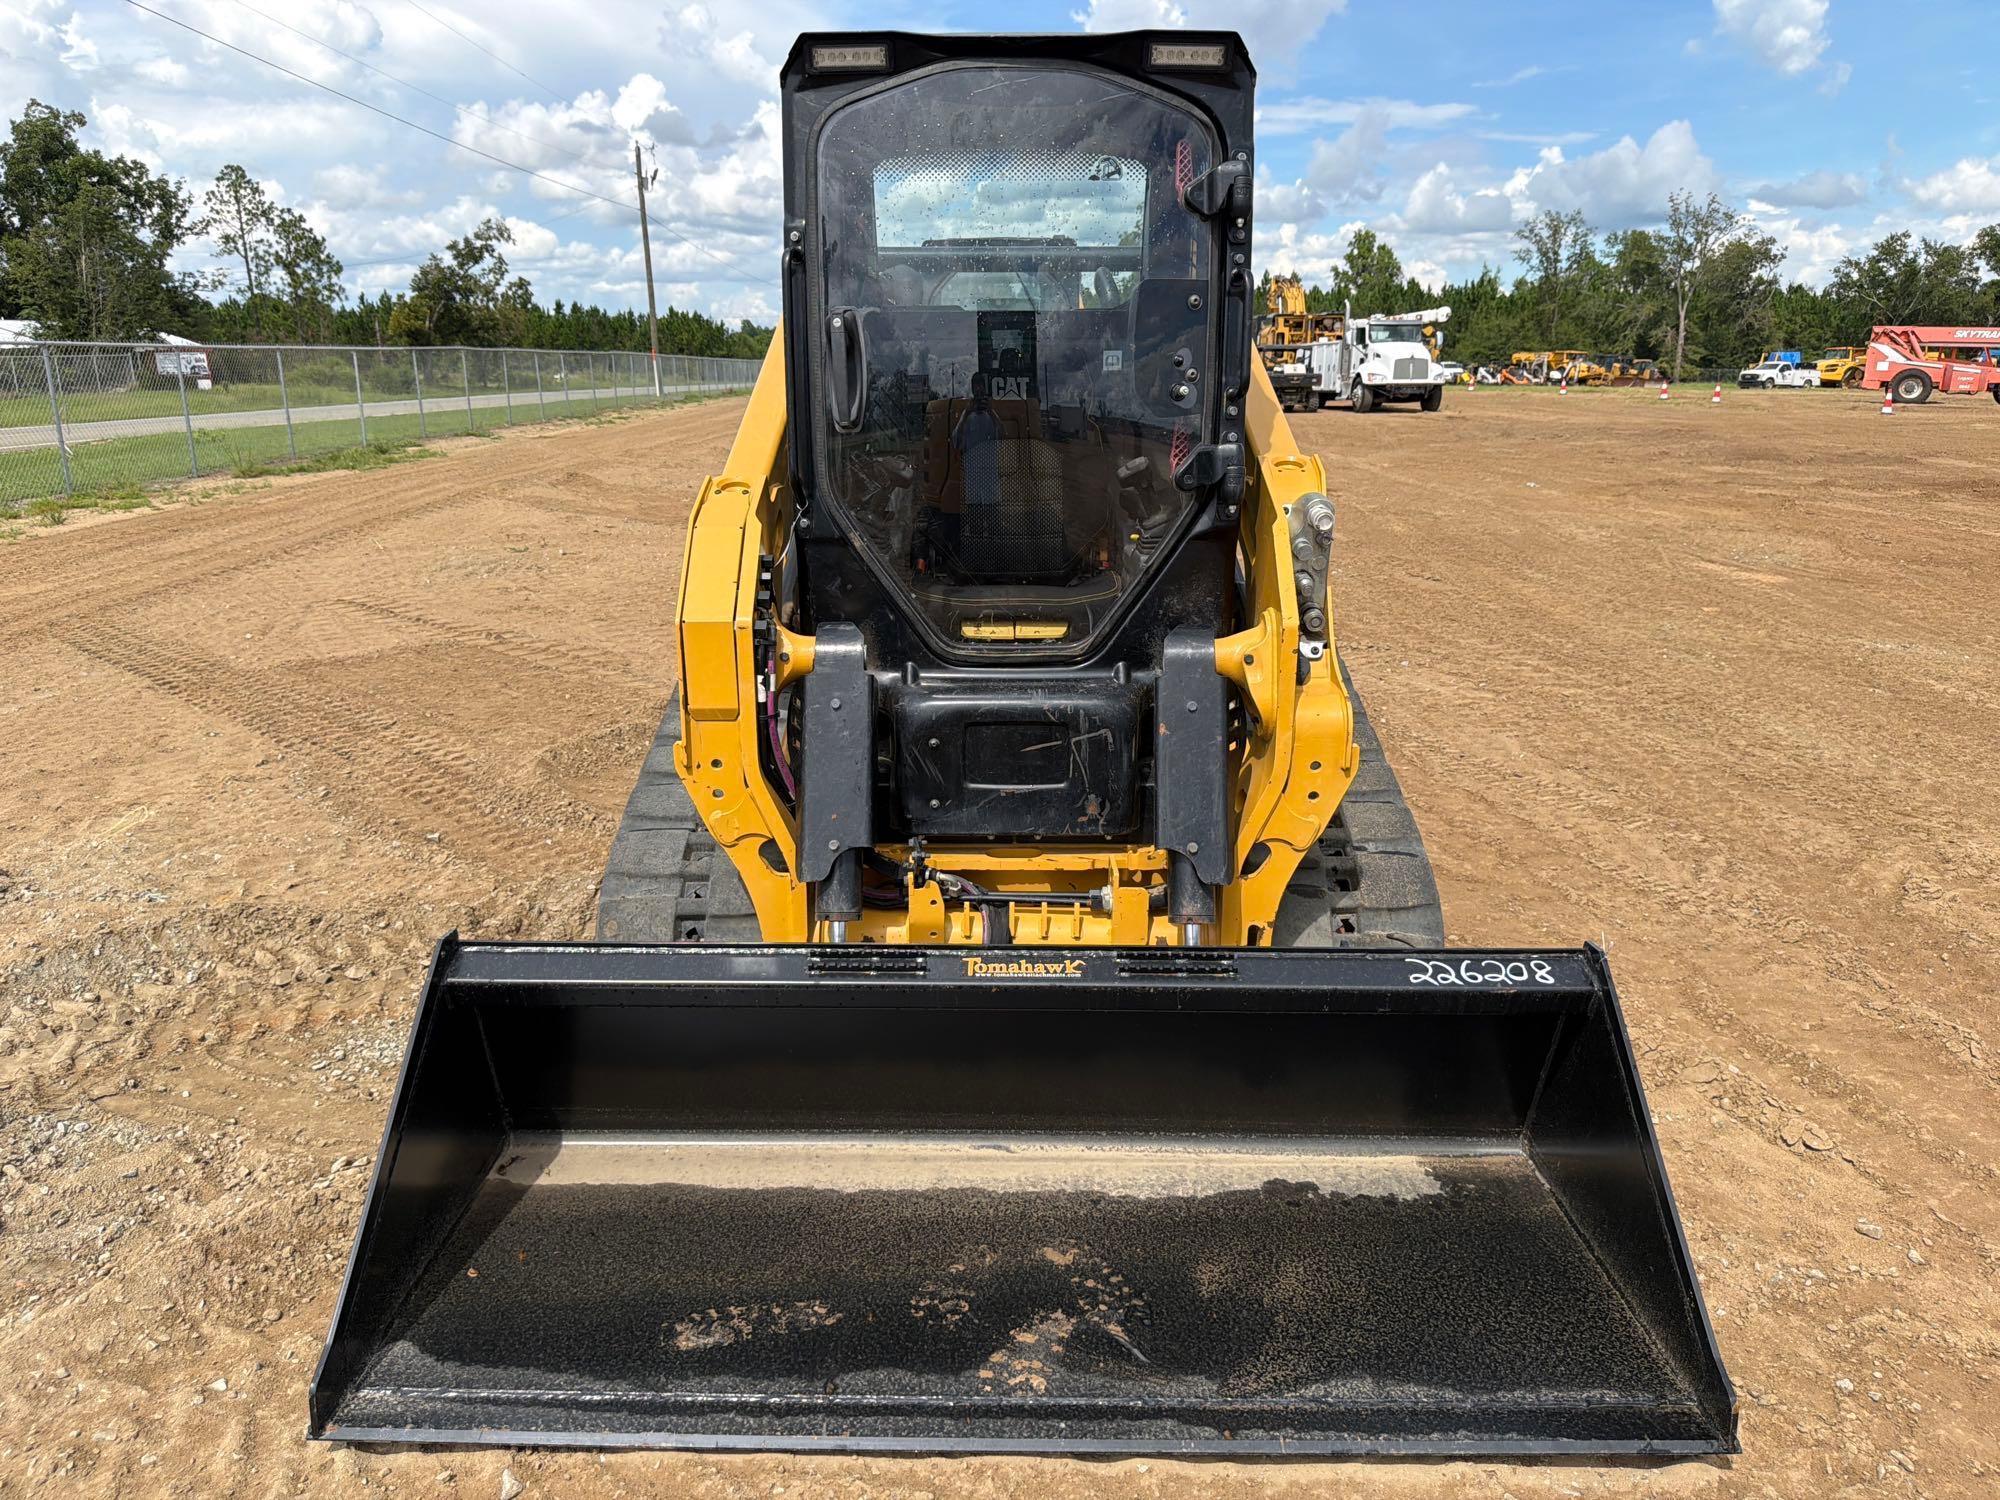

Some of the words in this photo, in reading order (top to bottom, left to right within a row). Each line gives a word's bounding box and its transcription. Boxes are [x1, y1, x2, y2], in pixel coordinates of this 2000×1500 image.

[1954, 330, 2000, 339] SKYTRA
[991, 376, 1030, 400] CAT
[1404, 958, 1555, 986] 226208
